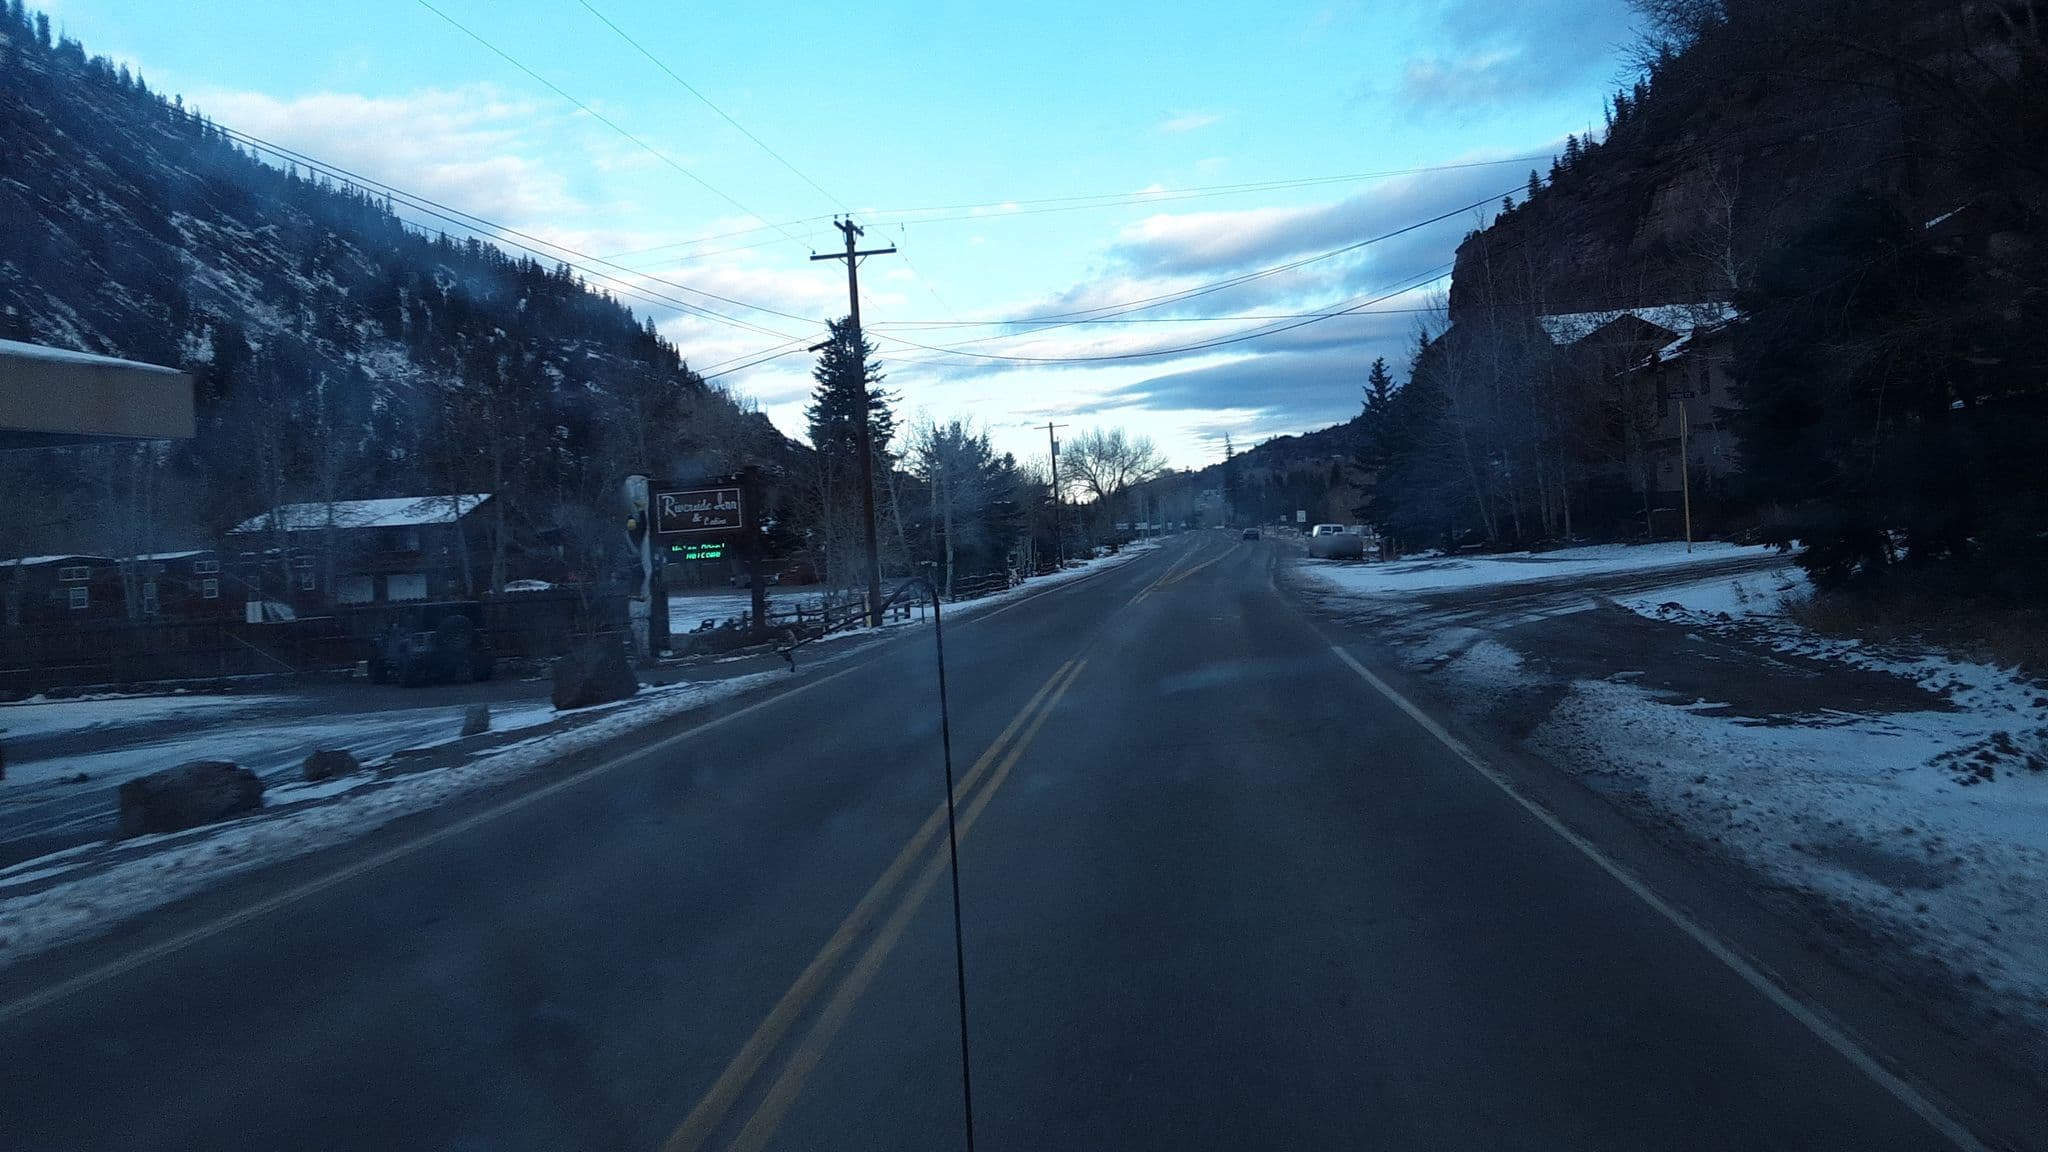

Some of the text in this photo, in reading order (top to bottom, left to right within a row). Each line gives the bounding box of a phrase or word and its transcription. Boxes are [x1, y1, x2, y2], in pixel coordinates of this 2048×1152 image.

[662, 492, 737, 517] Riverside Inn
[692, 513, 702, 522] &
